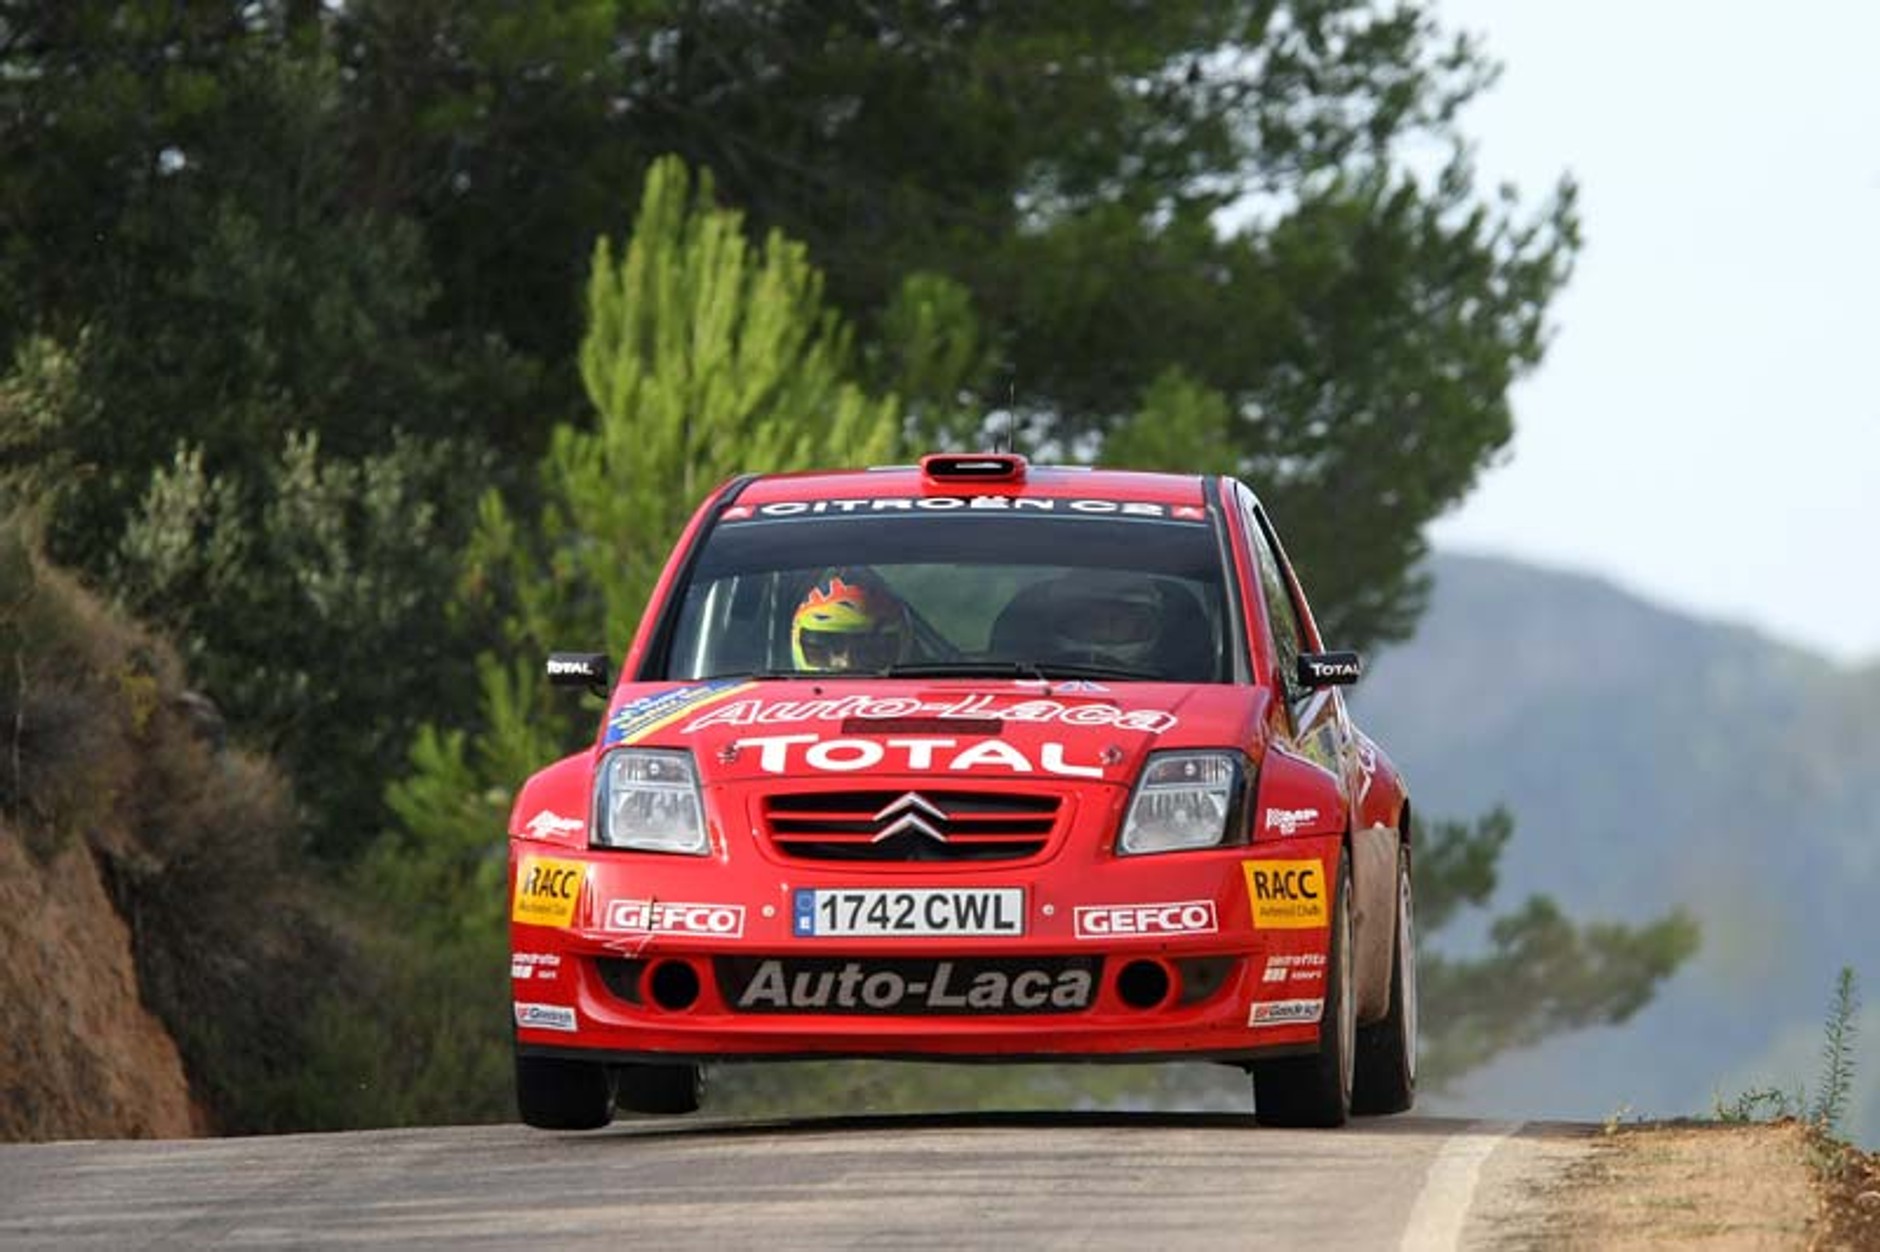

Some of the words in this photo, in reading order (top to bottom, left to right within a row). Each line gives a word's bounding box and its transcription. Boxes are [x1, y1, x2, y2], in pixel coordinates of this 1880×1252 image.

[1069, 500, 1164, 516] C2
[546, 660, 594, 675] TOTAL
[1310, 662, 1360, 678] TOTAL
[681, 693, 1178, 734] Auto-Laca
[735, 734, 1104, 778] TOTAL
[524, 866, 577, 899] RACC
[1253, 869, 1318, 899] RACC
[614, 905, 736, 932] GEFCO
[821, 893, 916, 931] 1742
[924, 893, 1015, 931] CWL
[1083, 905, 1209, 933] GEFCO
[737, 959, 1093, 1008] Auto-Laca
